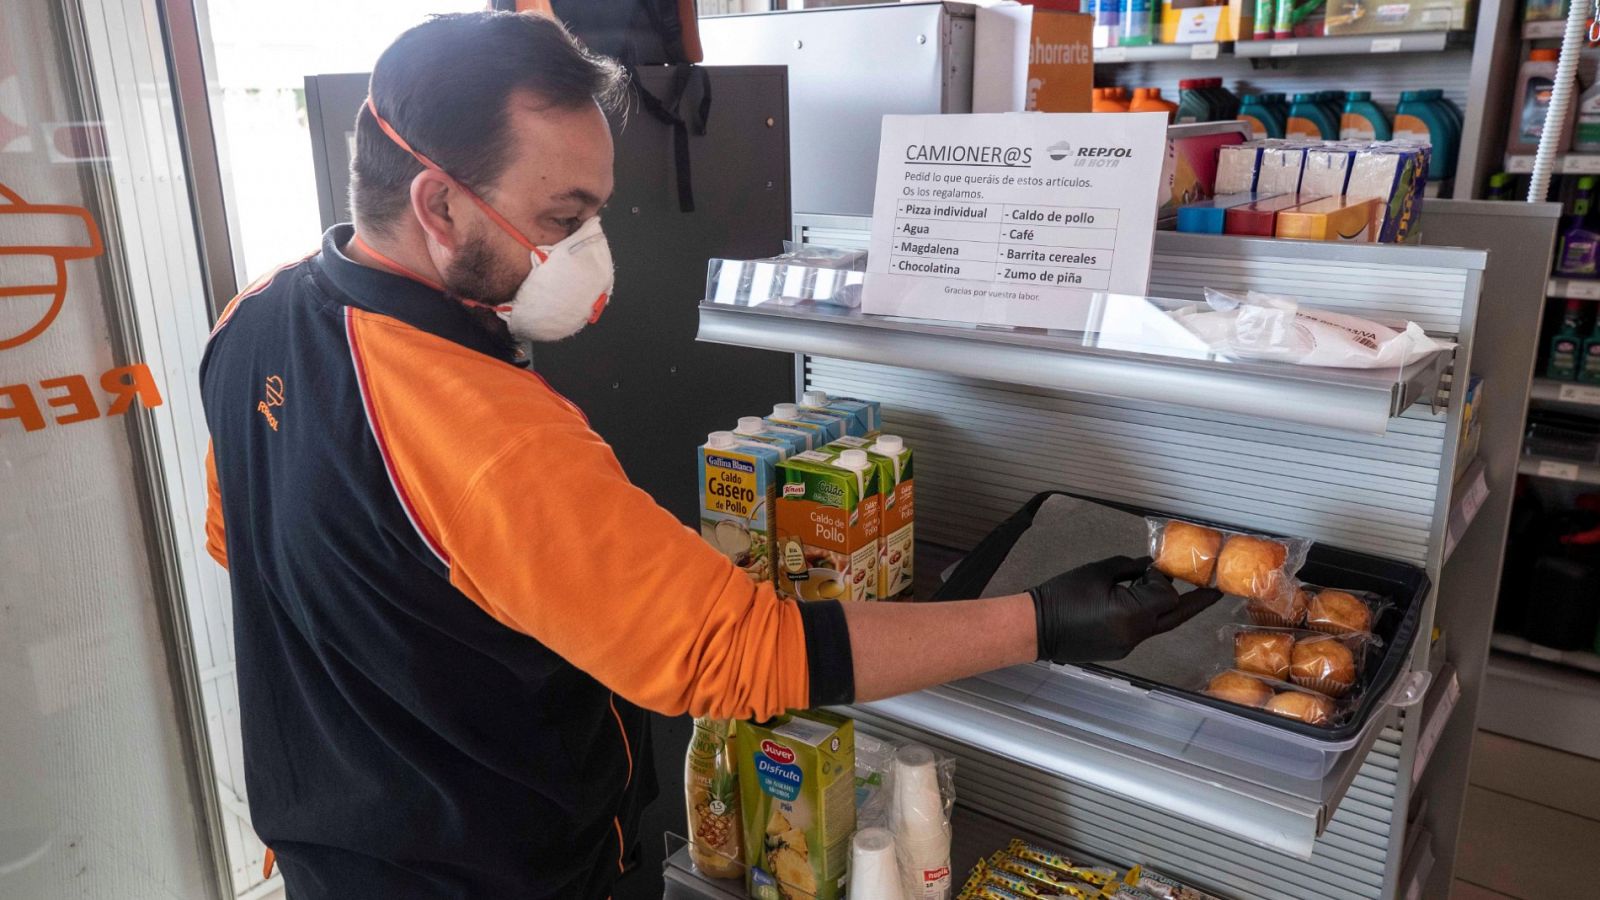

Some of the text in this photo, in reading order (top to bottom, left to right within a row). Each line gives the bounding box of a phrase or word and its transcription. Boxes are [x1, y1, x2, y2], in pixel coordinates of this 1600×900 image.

[906, 145, 1032, 165] CAMIONER@S
[1077, 147, 1132, 158] REPSOL
[904, 172, 1093, 187] Pedid lo que queráis de estos artículos.
[903, 187, 984, 199] Os los regalamos.
[906, 205, 931, 215] Pizza
[934, 206, 987, 218] individual
[1012, 210, 1044, 221] Caldo
[1047, 212, 1061, 221] de
[1065, 214, 1095, 224] pollo
[903, 224, 929, 235] Agua
[1010, 230, 1034, 240] Café
[901, 242, 959, 255] Magdalena
[1007, 249, 1046, 262] Barrita
[1049, 253, 1096, 264] cereales
[899, 261, 960, 275] Chocolatina
[1004, 269, 1037, 281] Zumo
[1040, 271, 1054, 281] de
[1057, 273, 1082, 284] piña
[944, 286, 971, 296] Gracias
[988, 291, 1016, 299] vuestra
[1018, 291, 1040, 301] labor.
[709, 456, 753, 472] Gallina Blanca
[721, 472, 741, 484] Caldo
[709, 478, 754, 502] Casero
[716, 500, 747, 514] de Pollo
[810, 512, 845, 528] Caldo de
[816, 526, 845, 544] Pollo
[765, 745, 792, 760] Juver
[759, 761, 800, 782] Disfruta
